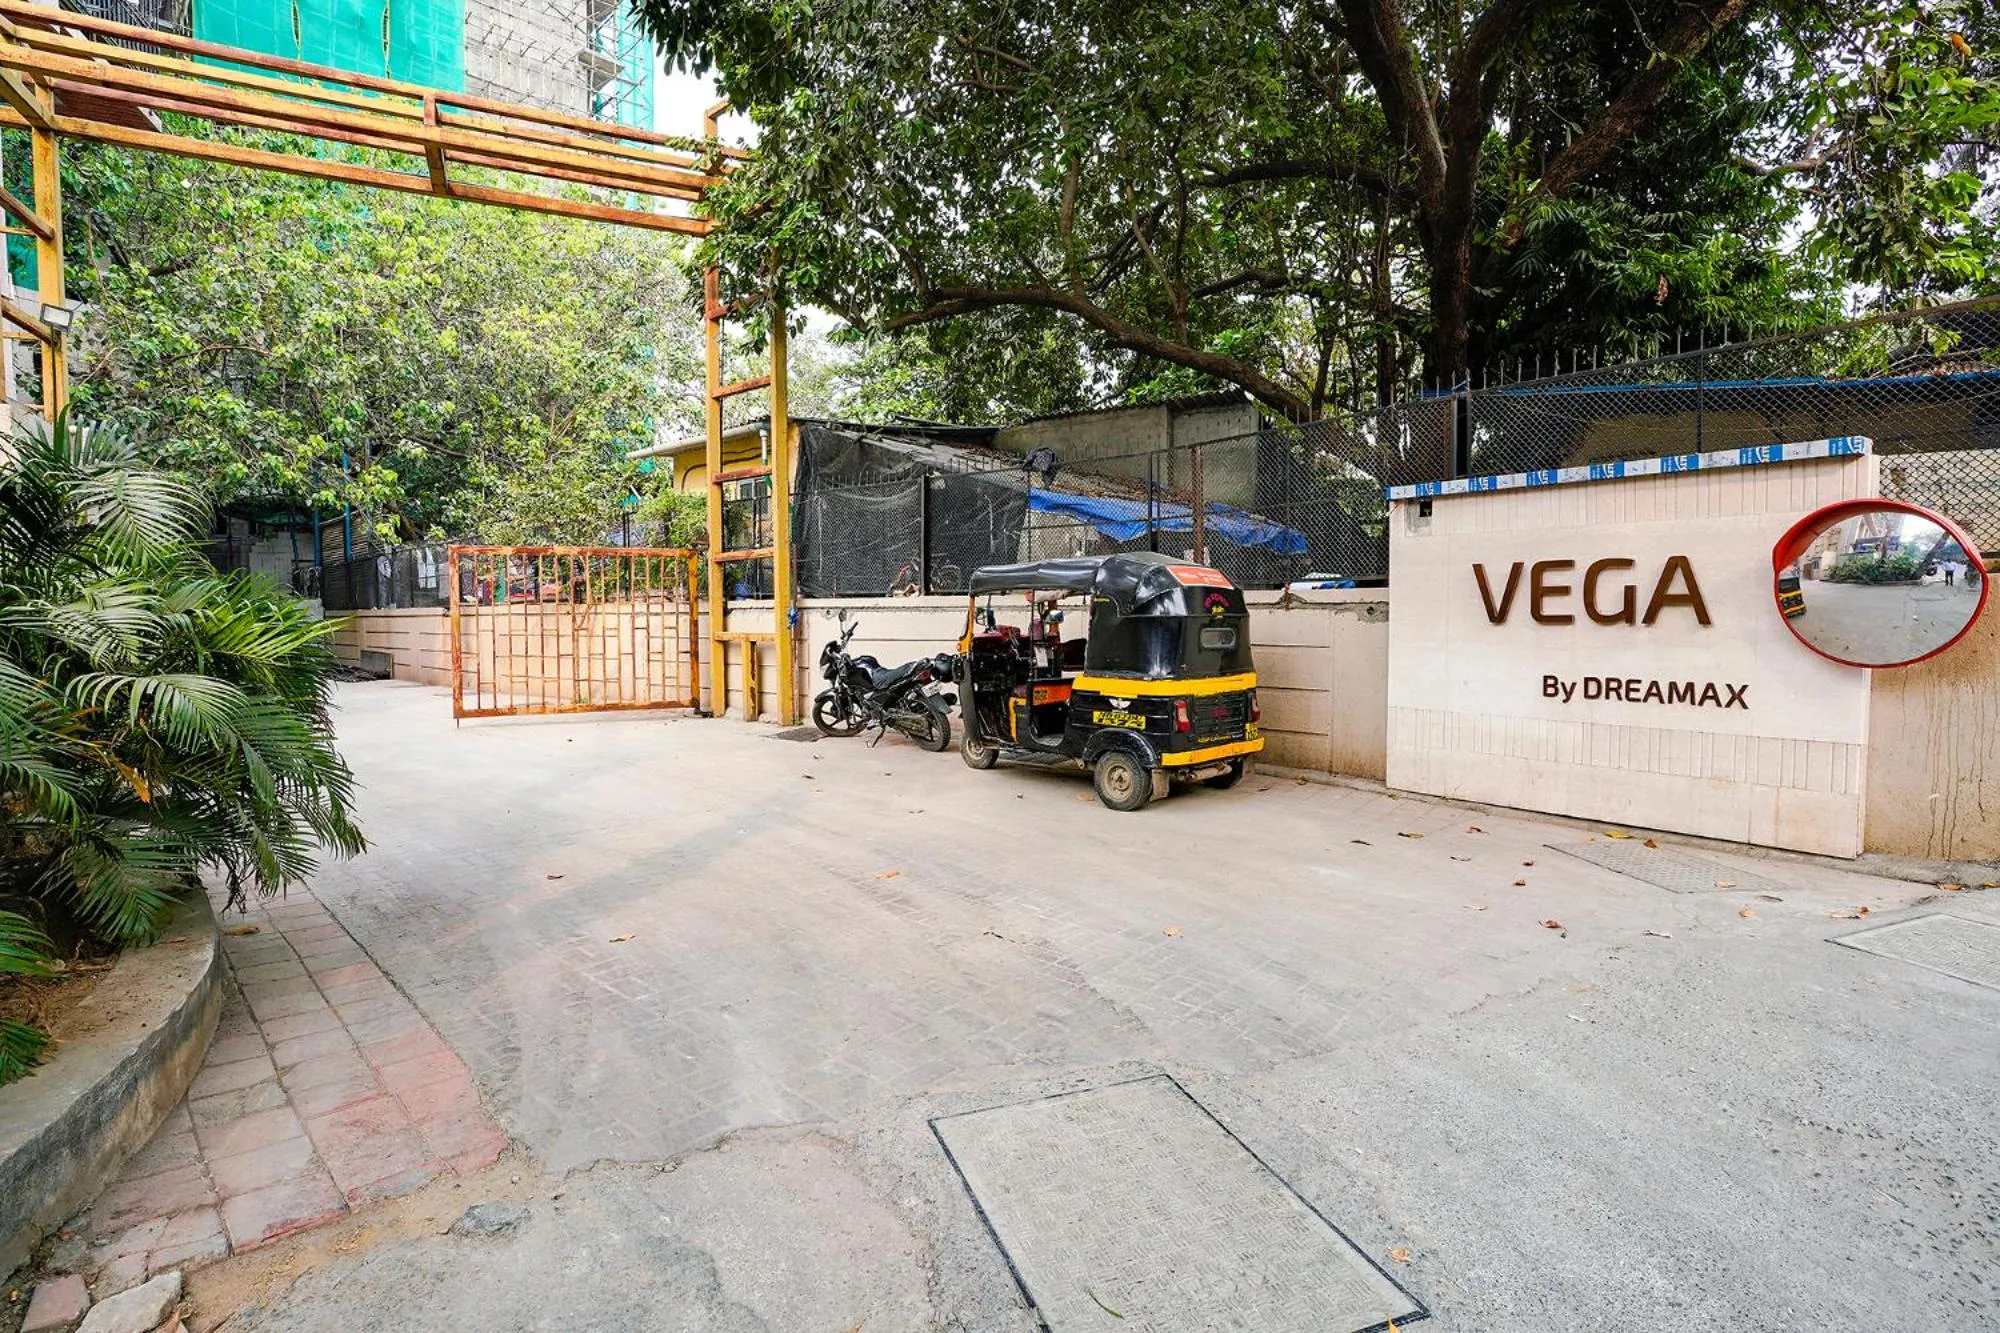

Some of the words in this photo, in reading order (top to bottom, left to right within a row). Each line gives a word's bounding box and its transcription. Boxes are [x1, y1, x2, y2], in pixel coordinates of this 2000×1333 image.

[1471, 555, 1712, 628] VEGA
[1542, 675, 1578, 705] By
[1583, 676, 1750, 710] DREAMAX
